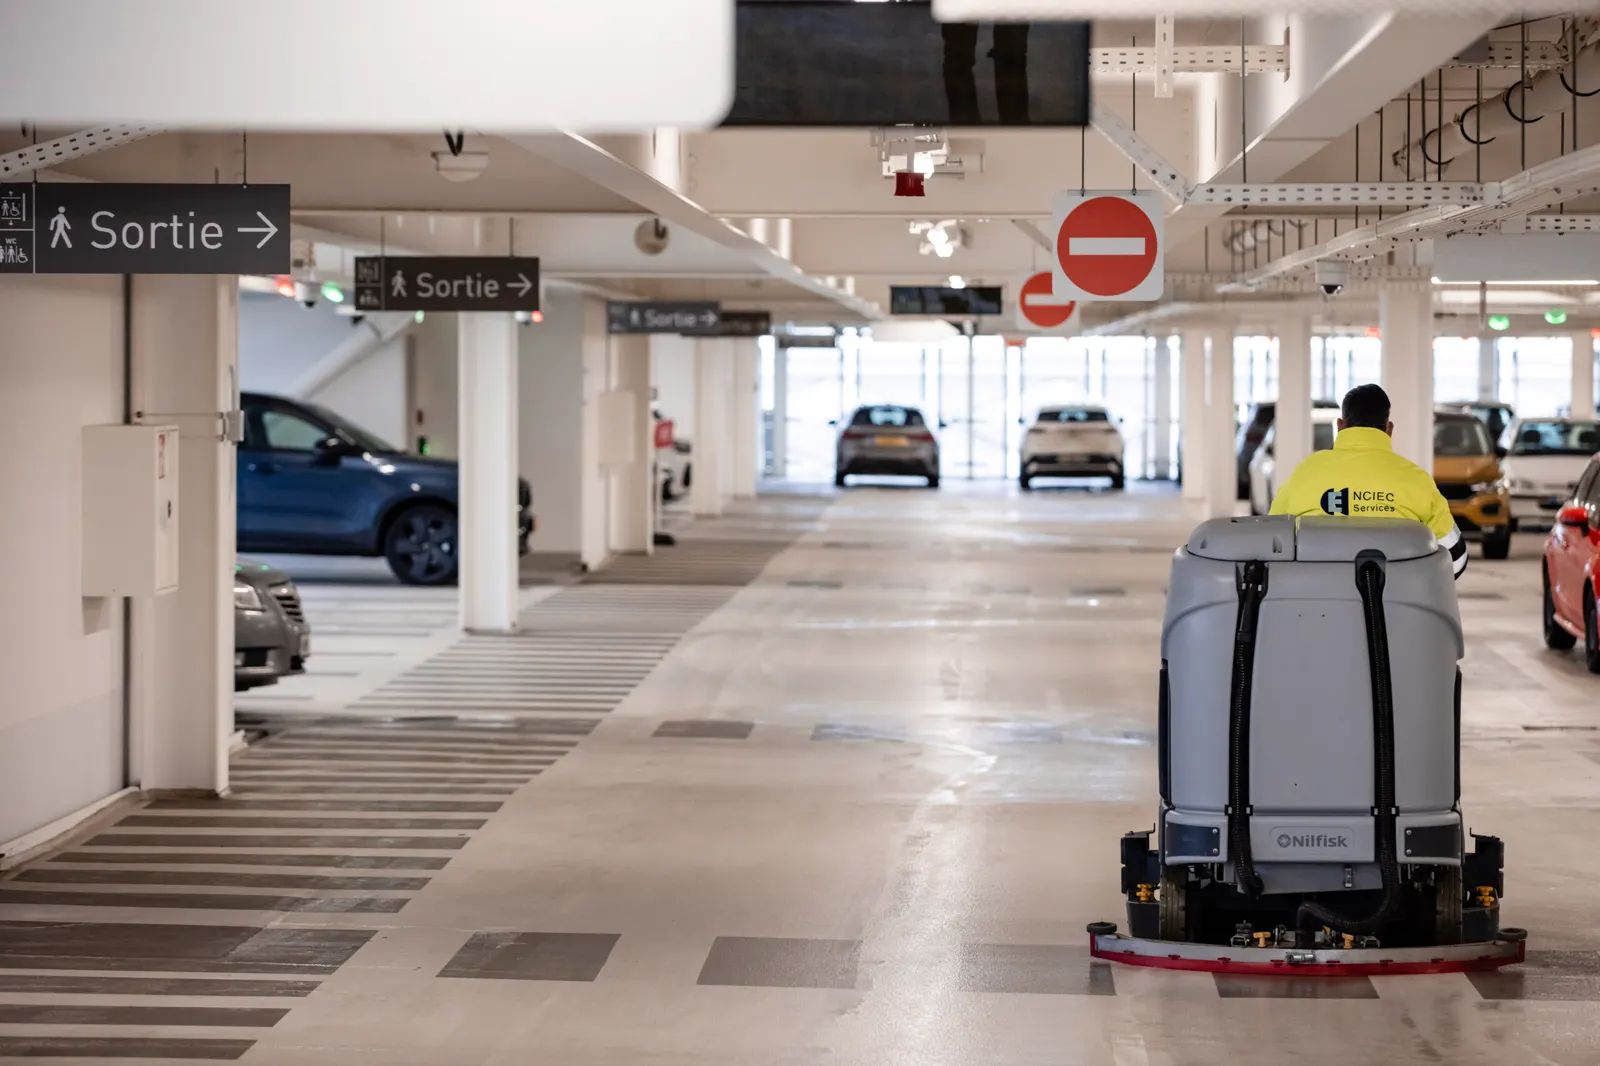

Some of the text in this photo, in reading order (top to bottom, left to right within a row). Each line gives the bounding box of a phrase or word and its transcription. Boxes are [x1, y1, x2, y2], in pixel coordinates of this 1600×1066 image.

[91, 211, 223, 249] Sortie
[416, 272, 500, 298] Sortie
[645, 309, 697, 328] Sortie
[1353, 491, 1395, 502] NCIEC
[1353, 504, 1395, 512] Services
[1293, 835, 1348, 848] Nilfisk
